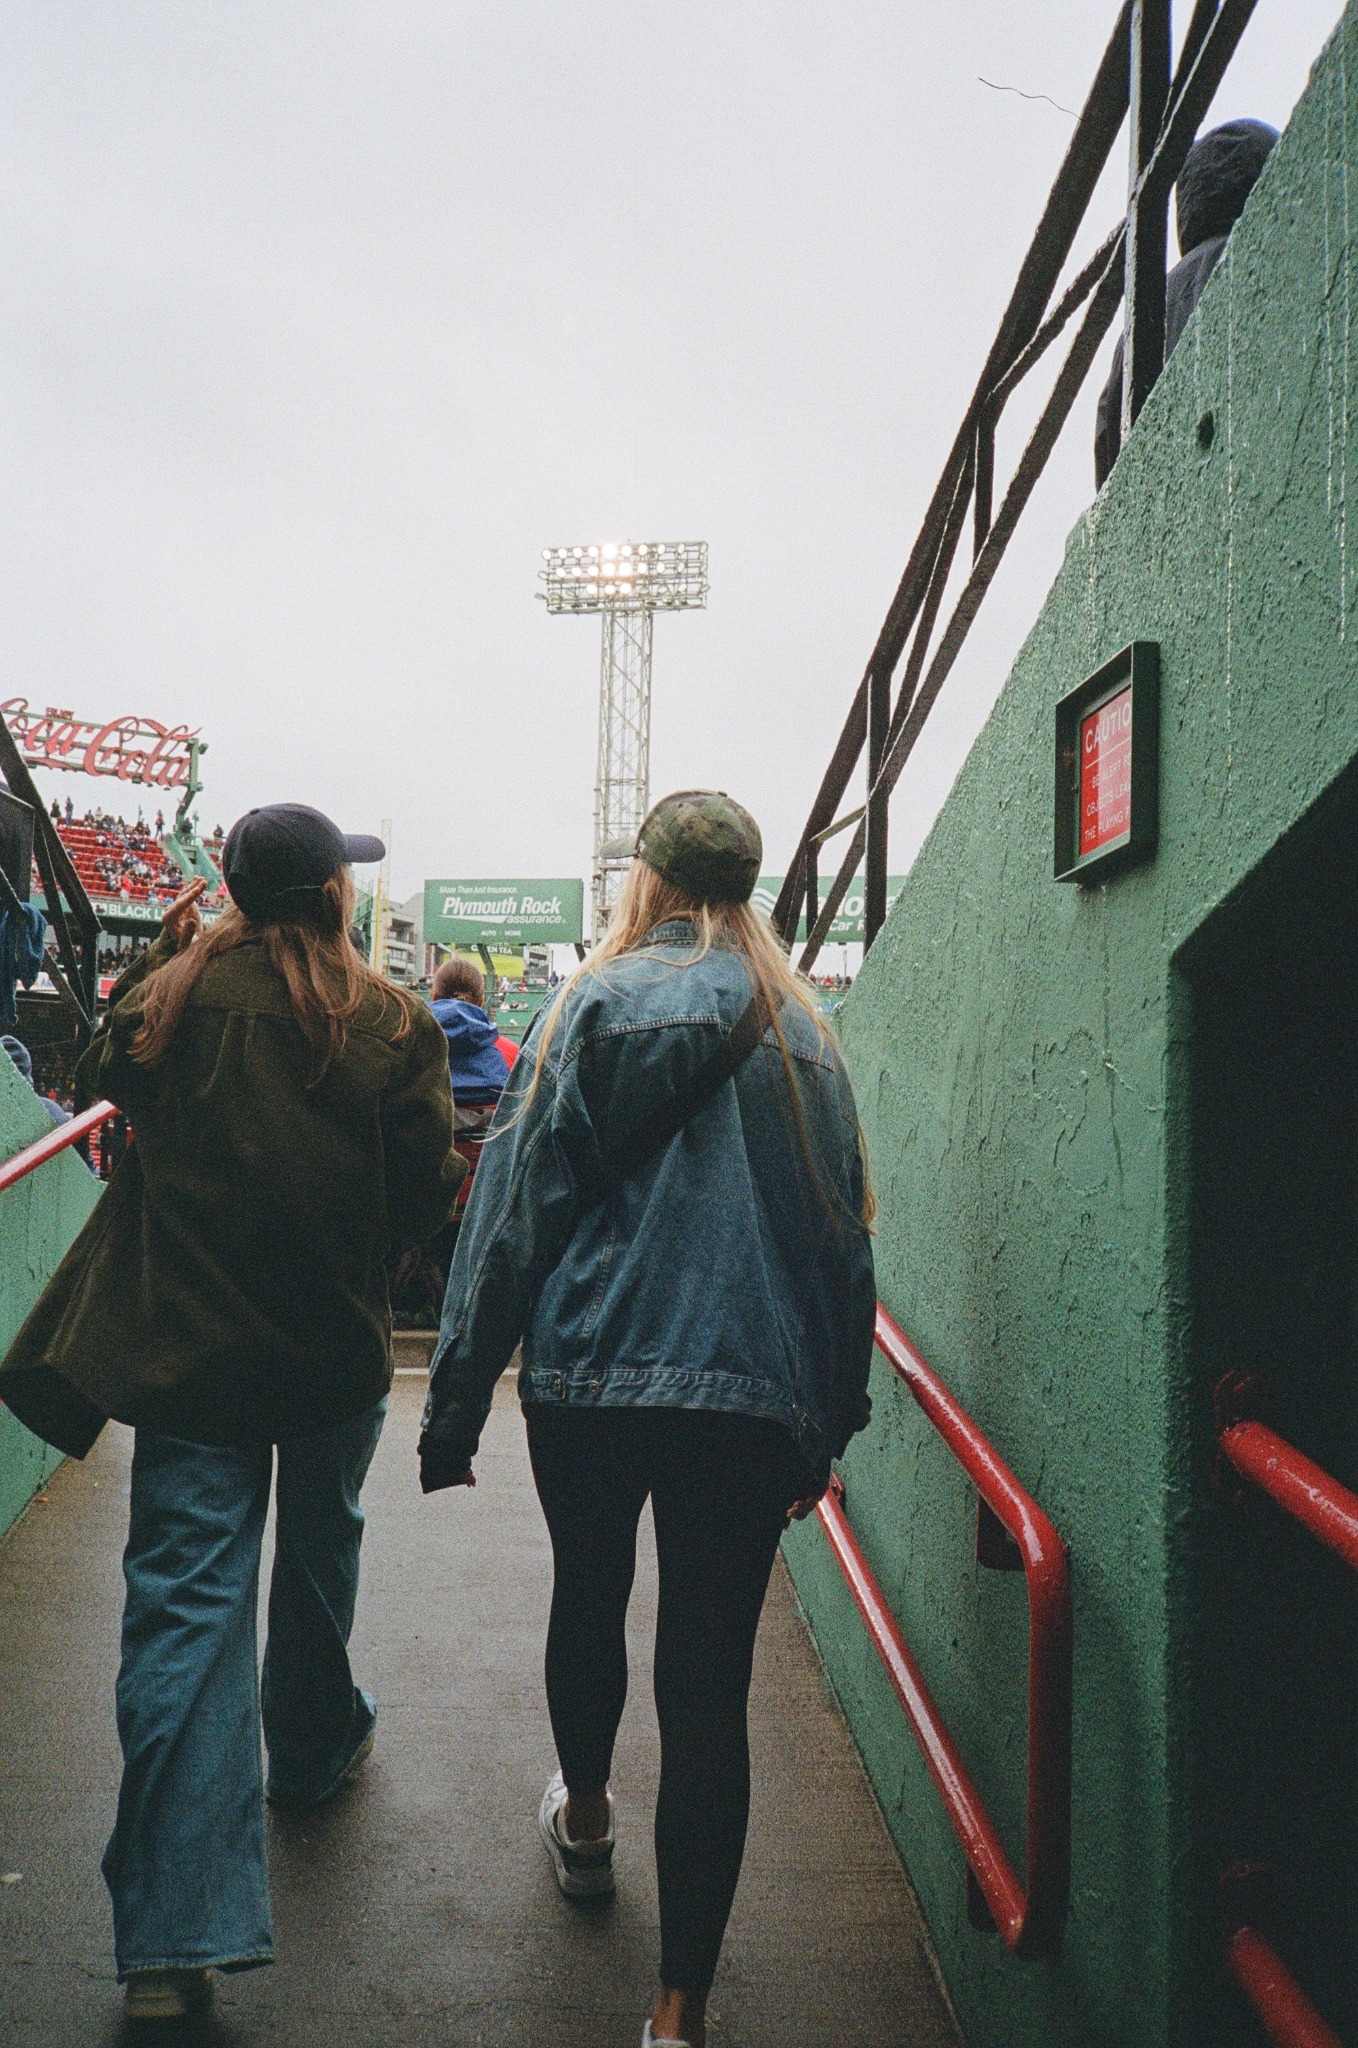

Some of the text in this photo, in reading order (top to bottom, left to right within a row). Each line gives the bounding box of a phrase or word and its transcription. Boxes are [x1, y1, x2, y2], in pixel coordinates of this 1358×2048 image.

[1085, 702, 1131, 753] CAUTIO
[1085, 826, 1097, 843] THE
[1099, 810, 1123, 837] PLAYING
[439, 886, 457, 894] More
[457, 886, 473, 894] Than
[473, 886, 487, 894] Just
[108, 902, 152, 919] BLACK
[442, 896, 562, 918] Plymouth Rock
[506, 915, 562, 924] assurance
[829, 919, 854, 931] Car
[470, 944, 513, 956] GEN TEA
